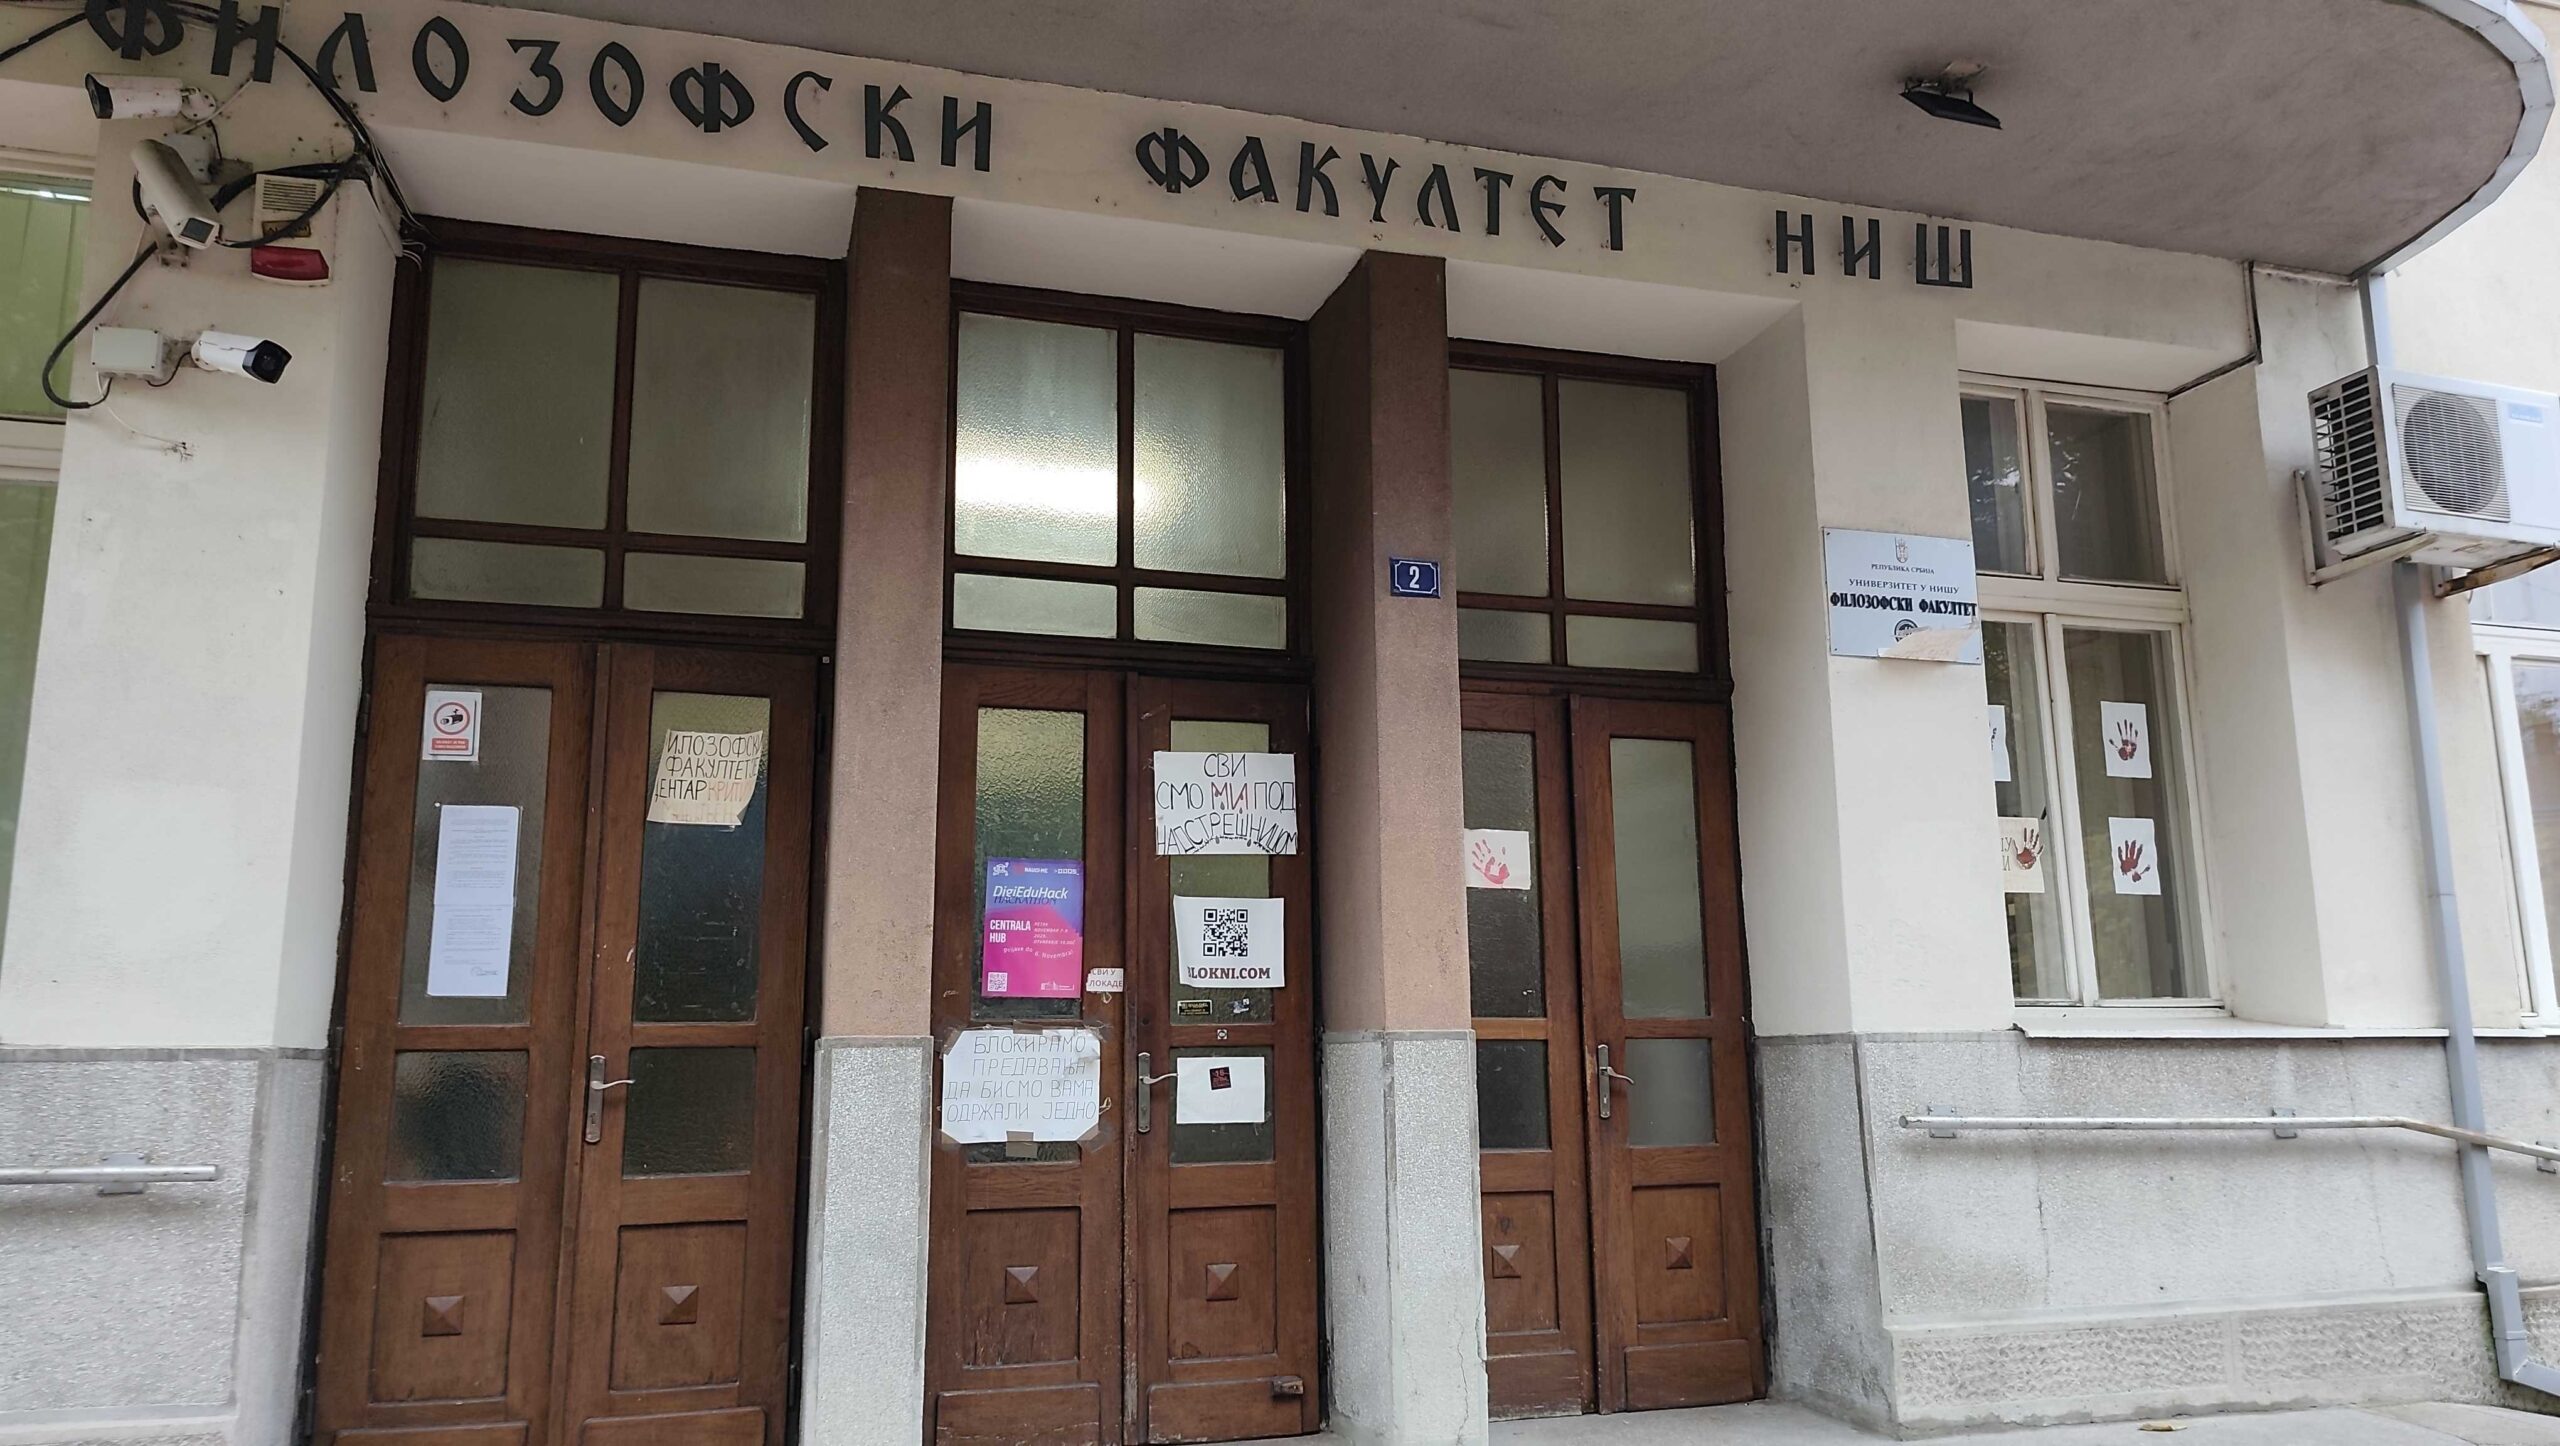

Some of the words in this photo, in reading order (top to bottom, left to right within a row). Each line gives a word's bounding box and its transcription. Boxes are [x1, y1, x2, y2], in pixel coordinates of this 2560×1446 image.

[85, 0, 992, 173] ФИЛОЗОФСКИ
[1135, 127, 1637, 251] ФАКУЛТЕТ
[1775, 210, 1973, 288] НИШ
[1409, 565, 1420, 589] 2
[1871, 563, 1910, 573] РЕПУБЛИКА
[1911, 567, 1935, 575] СРБИЈА
[1849, 578, 1917, 591] УНИВЕРЗИТЕТ
[1920, 584, 1928, 592] У
[1929, 585, 1960, 595] НИШУ
[1830, 592, 1913, 612] ФИЛОЗОФСКИ
[1919, 599, 1977, 617] ФАКУЛТЕТ
[1203, 753, 1246, 777] СВИ
[1156, 781, 1204, 810] СМО
[1211, 782, 1248, 810] МИ
[1254, 781, 1295, 813] ПОД
[1157, 812, 1297, 855] НАДСТРЕШНИЦОМ
[993, 885, 1069, 899] DigiEduHack
[989, 919, 1031, 931] CENTRALA
[989, 932, 1007, 943] HUB
[974, 1035, 1086, 1054] БЛОКИРАМО
[972, 1056, 1086, 1076] ПРЕДАВАЊА
[944, 1081, 971, 1100] ДА
[980, 1079, 1043, 1098] БИСМО
[1051, 1079, 1094, 1098] ВАМА
[946, 1103, 1029, 1122] ОДРЖАЛИ
[1041, 1101, 1096, 1120] ЈЕДНО
